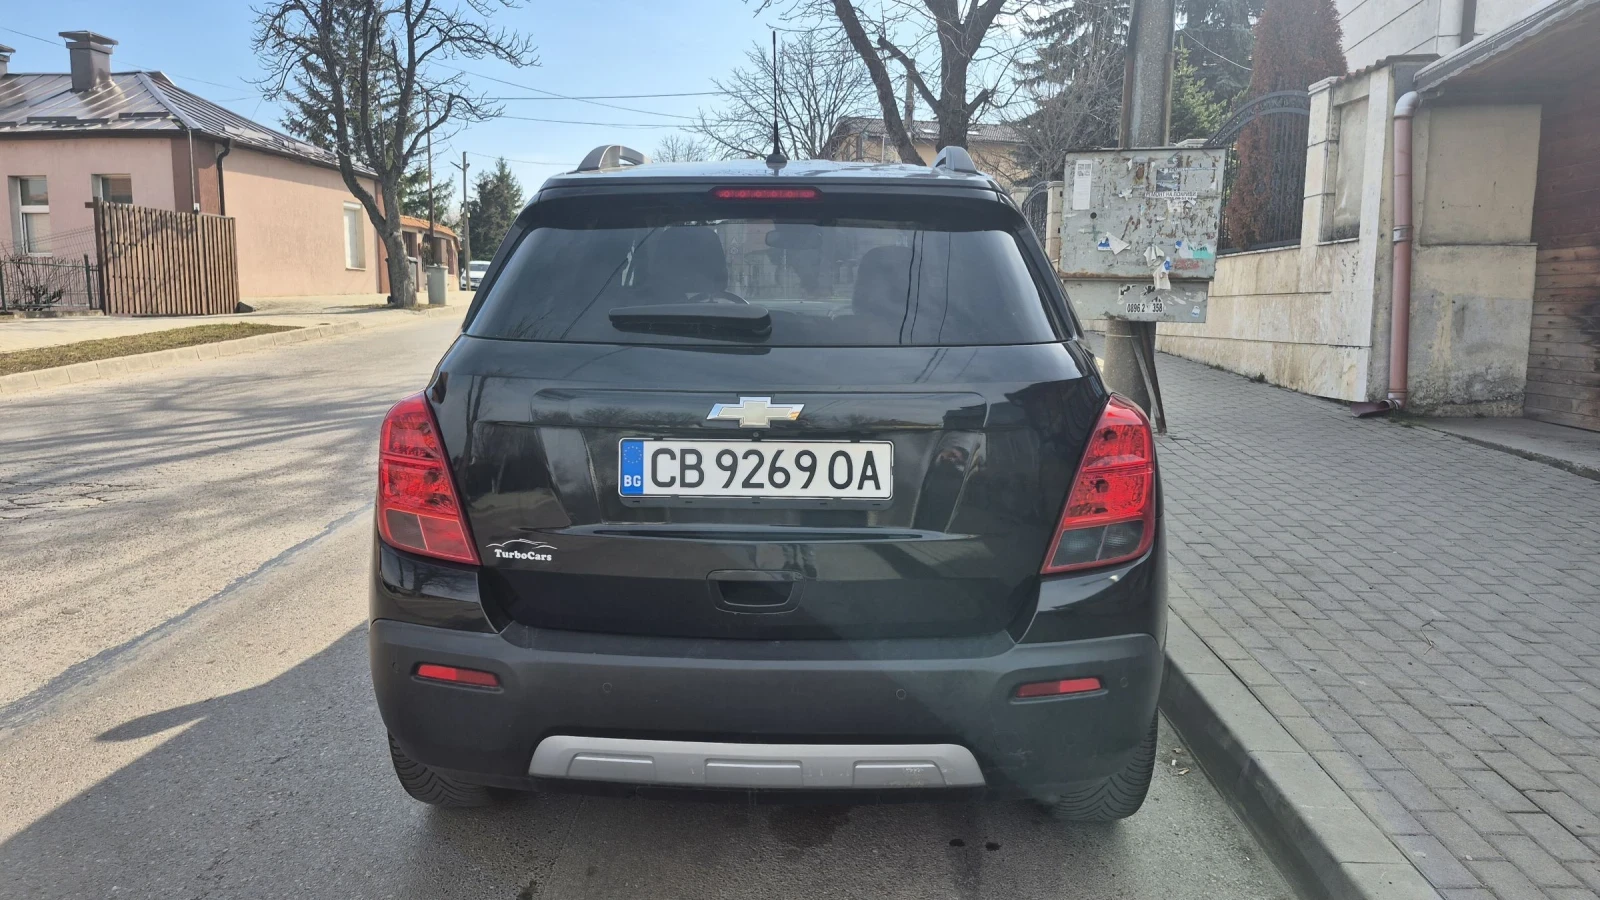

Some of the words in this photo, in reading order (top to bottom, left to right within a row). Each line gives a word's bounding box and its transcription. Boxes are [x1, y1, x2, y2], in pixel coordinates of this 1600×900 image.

[1127, 303, 1140, 313] 0896
[1152, 303, 1163, 313] 358
[651, 448, 704, 488] CB
[715, 449, 817, 489] 9269
[828, 450, 881, 490] OA
[624, 475, 641, 487] BG
[494, 548, 552, 561] TurboCars
